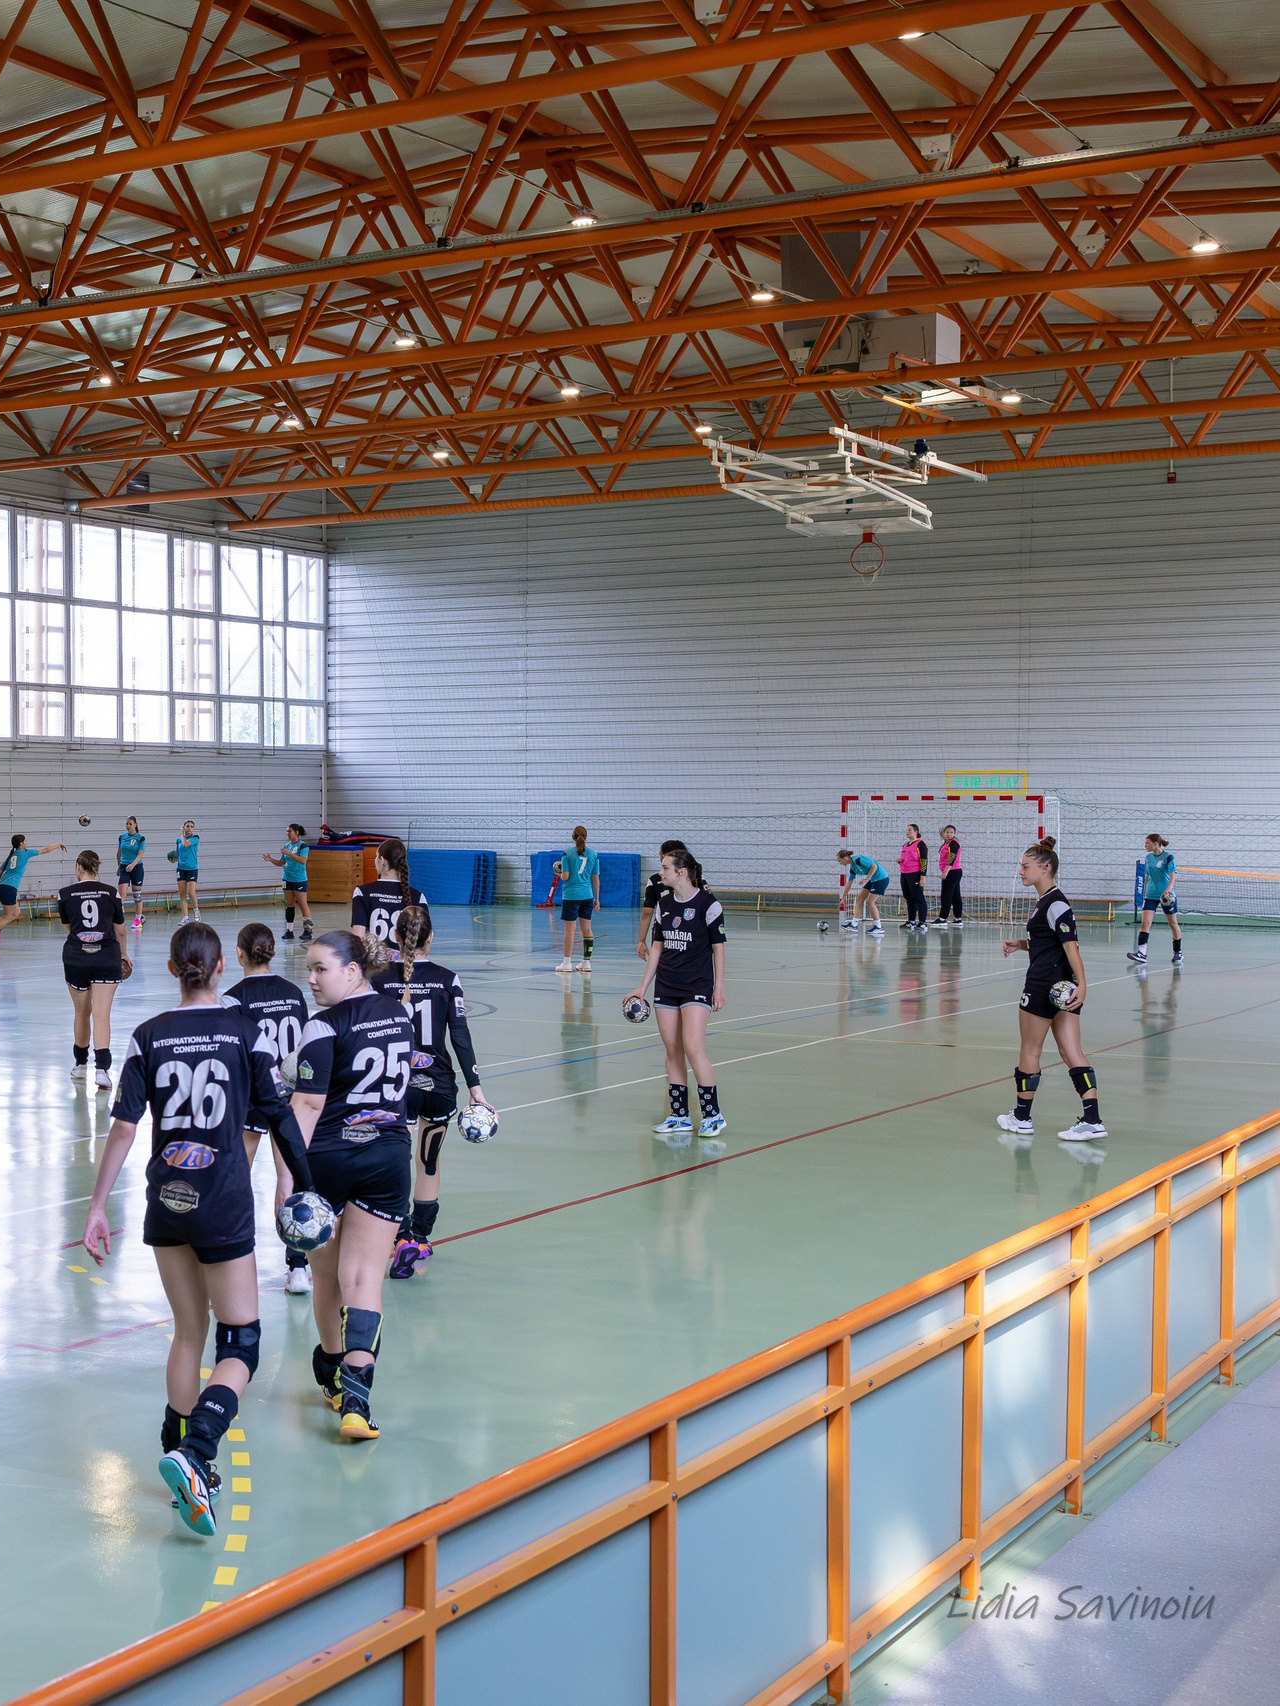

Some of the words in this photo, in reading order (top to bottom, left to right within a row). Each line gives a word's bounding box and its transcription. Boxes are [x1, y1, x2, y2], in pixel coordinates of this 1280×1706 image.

[954, 776, 1019, 788] FAIR-PLAY
[578, 857, 588, 875] 7
[81, 899, 99, 928] 9
[249, 1000, 285, 1009] INTERNATIONAL
[263, 1005, 292, 1013] CONSTRUCT
[351, 1017, 394, 1033] INTERNATIONAL
[367, 1027, 402, 1039] CONSTRUCT
[152, 1035, 211, 1049] INTERNATIONAL
[212, 1034, 240, 1045] NIVAFIL
[173, 1043, 220, 1054] CONSTRUCT
[346, 1041, 410, 1105] 25
[155, 1058, 229, 1131] 26
